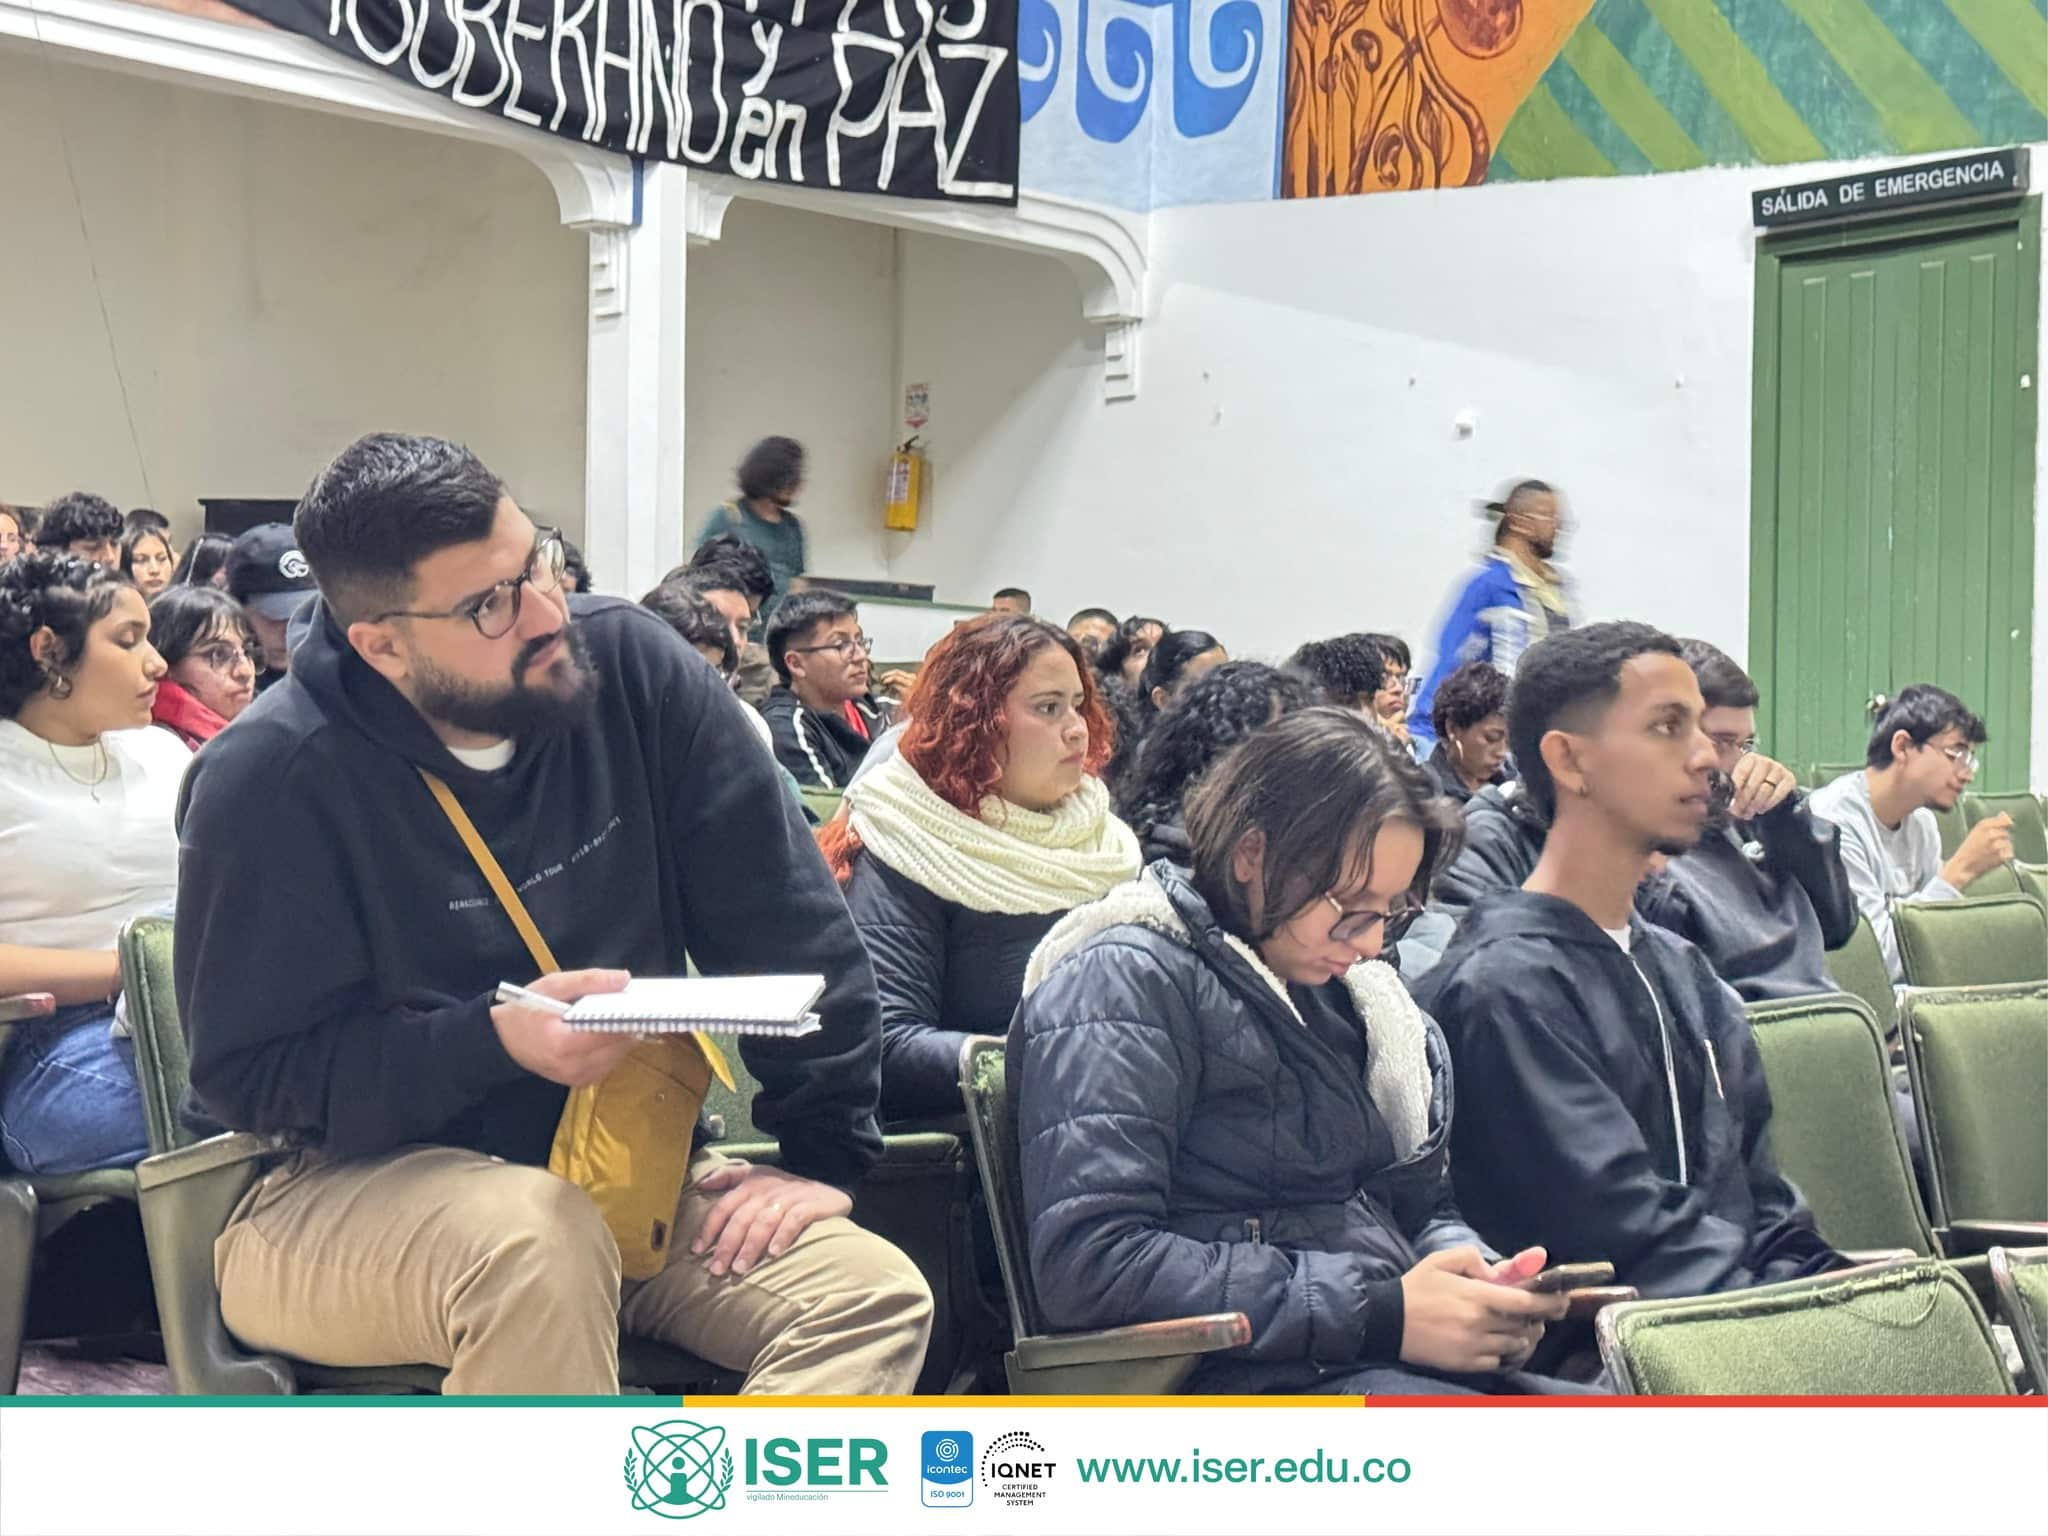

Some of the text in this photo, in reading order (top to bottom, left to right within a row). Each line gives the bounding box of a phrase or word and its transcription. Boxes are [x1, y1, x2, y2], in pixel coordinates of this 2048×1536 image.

[741, 19, 783, 96] y
[730, 97, 807, 181] en
[827, 31, 1014, 198] PAZ
[1839, 182, 1865, 204] DE
[1874, 159, 2005, 199] EMERGENCIA
